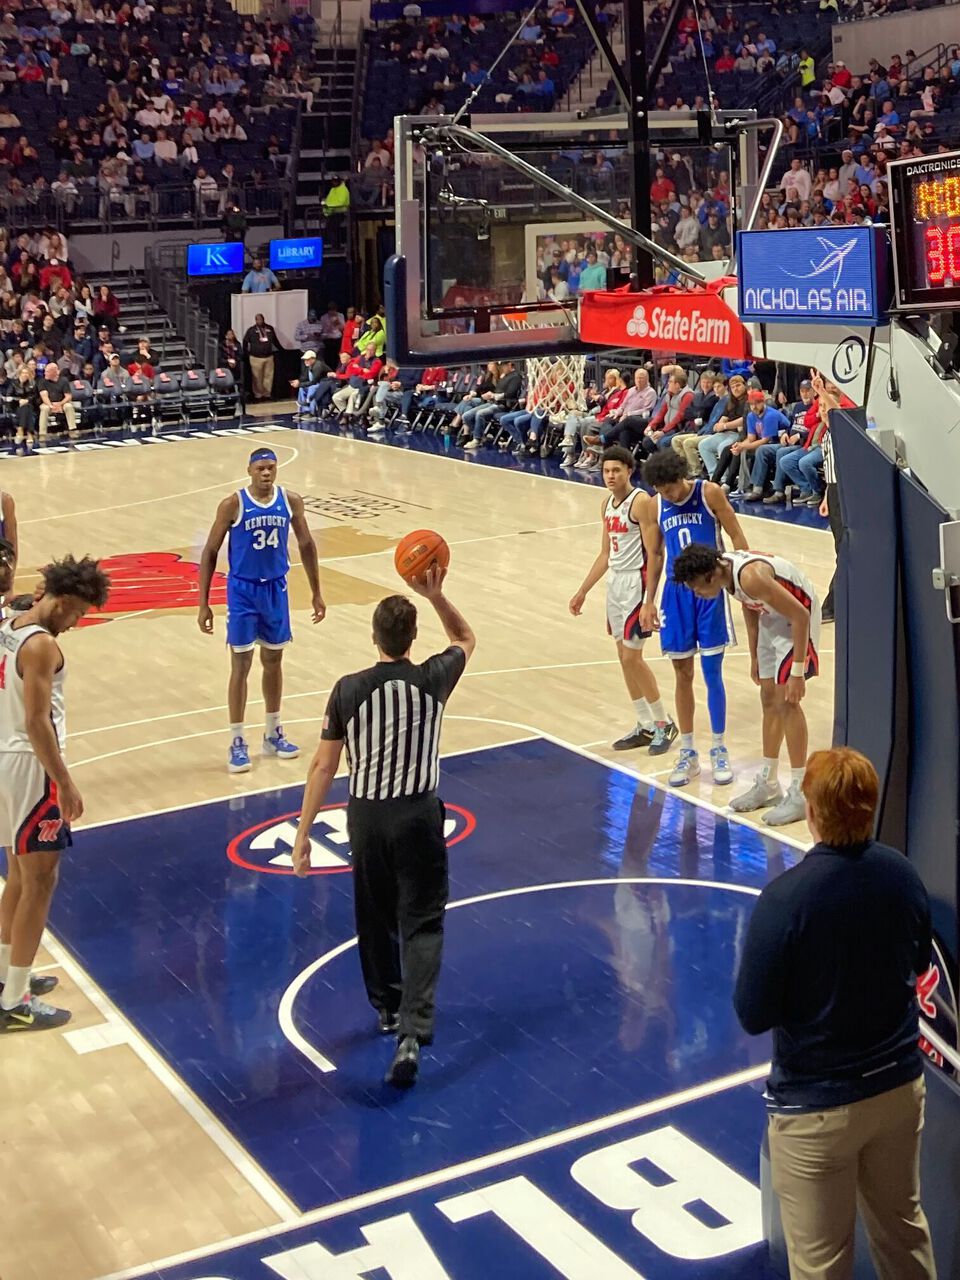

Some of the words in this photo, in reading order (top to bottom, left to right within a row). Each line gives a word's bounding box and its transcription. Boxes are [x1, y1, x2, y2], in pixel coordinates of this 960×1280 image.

[278, 246, 315, 258] LIBRARY
[745, 287, 833, 311] NICHOLAS
[836, 288, 867, 311] AIR
[245, 516, 287, 530] KENTUCKY
[662, 513, 703, 531] KENTUCKY
[252, 528, 280, 550] 34
[678, 528, 692, 550] 0
